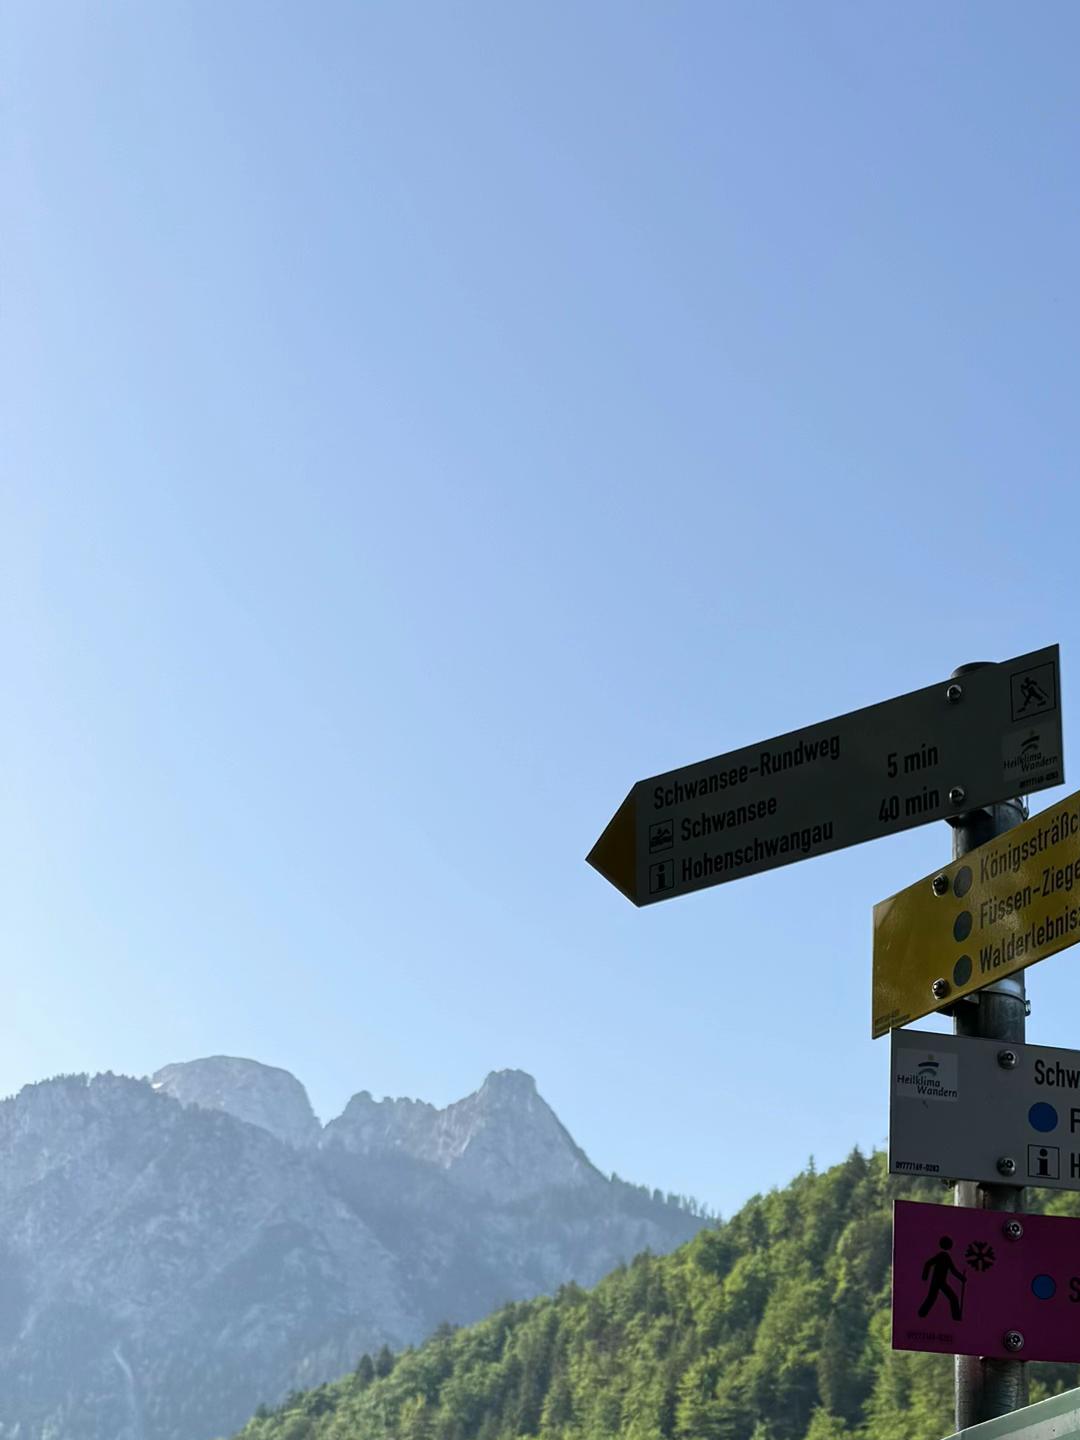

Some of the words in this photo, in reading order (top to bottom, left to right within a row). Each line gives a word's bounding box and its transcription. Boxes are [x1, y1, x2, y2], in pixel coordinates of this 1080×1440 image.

[653, 735, 840, 810] Schwansee-Rundweg
[680, 797, 777, 842] Schwansee
[886, 754, 897, 779] 5
[904, 743, 939, 773] min
[681, 821, 834, 883] Hohenschwangau
[878, 797, 900, 824] 40
[904, 786, 940, 816] min
[896, 1073, 941, 1088] Heilklima
[917, 1084, 958, 1099] Wandern
